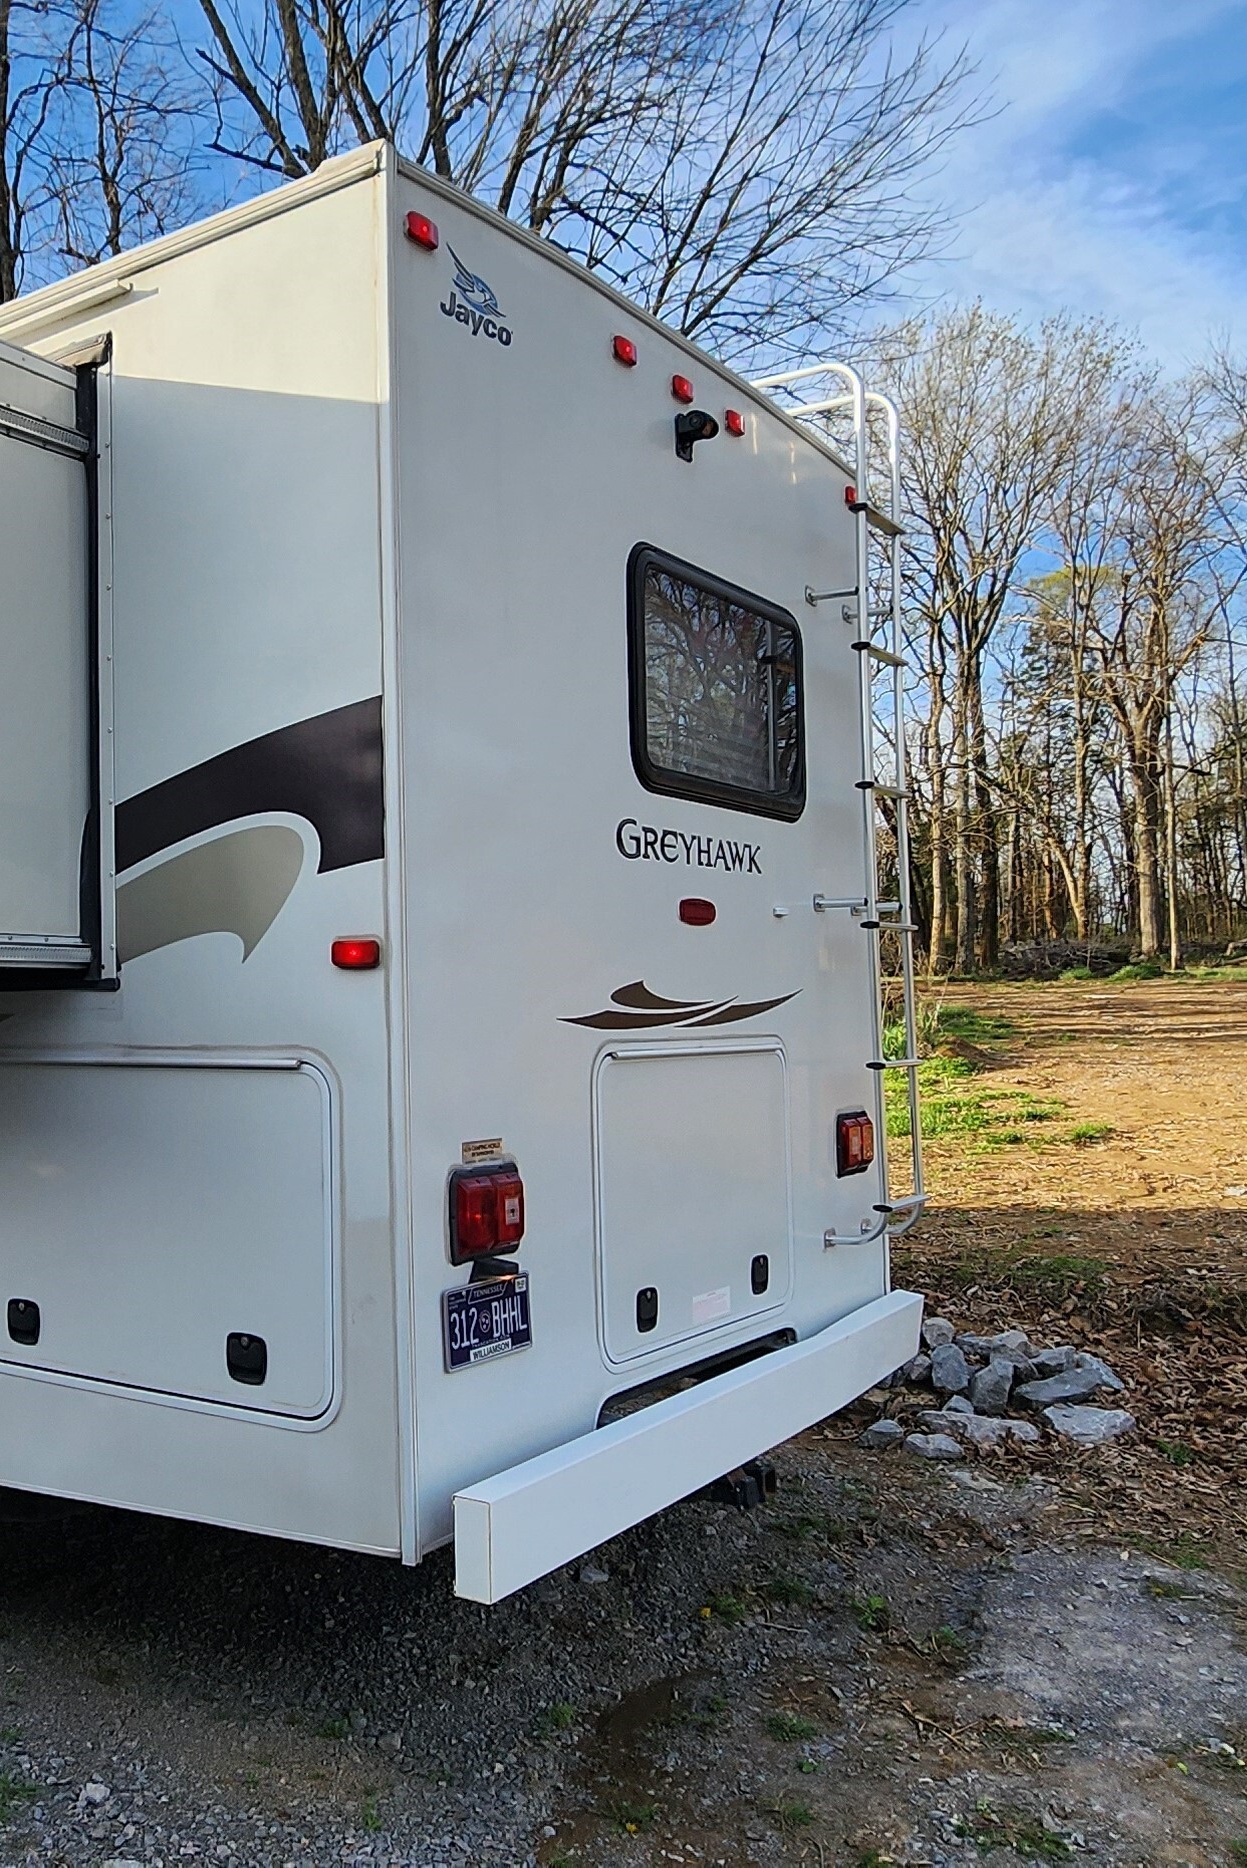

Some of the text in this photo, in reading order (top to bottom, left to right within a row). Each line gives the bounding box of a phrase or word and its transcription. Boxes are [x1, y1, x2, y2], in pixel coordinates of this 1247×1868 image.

[440, 291, 512, 346] Jayco
[616, 818, 763, 875] GREYHAWK
[473, 1283, 504, 1298] TENNESSEE
[450, 1295, 528, 1350] 312 BHHL
[472, 1341, 511, 1361] WILLIAMSON
